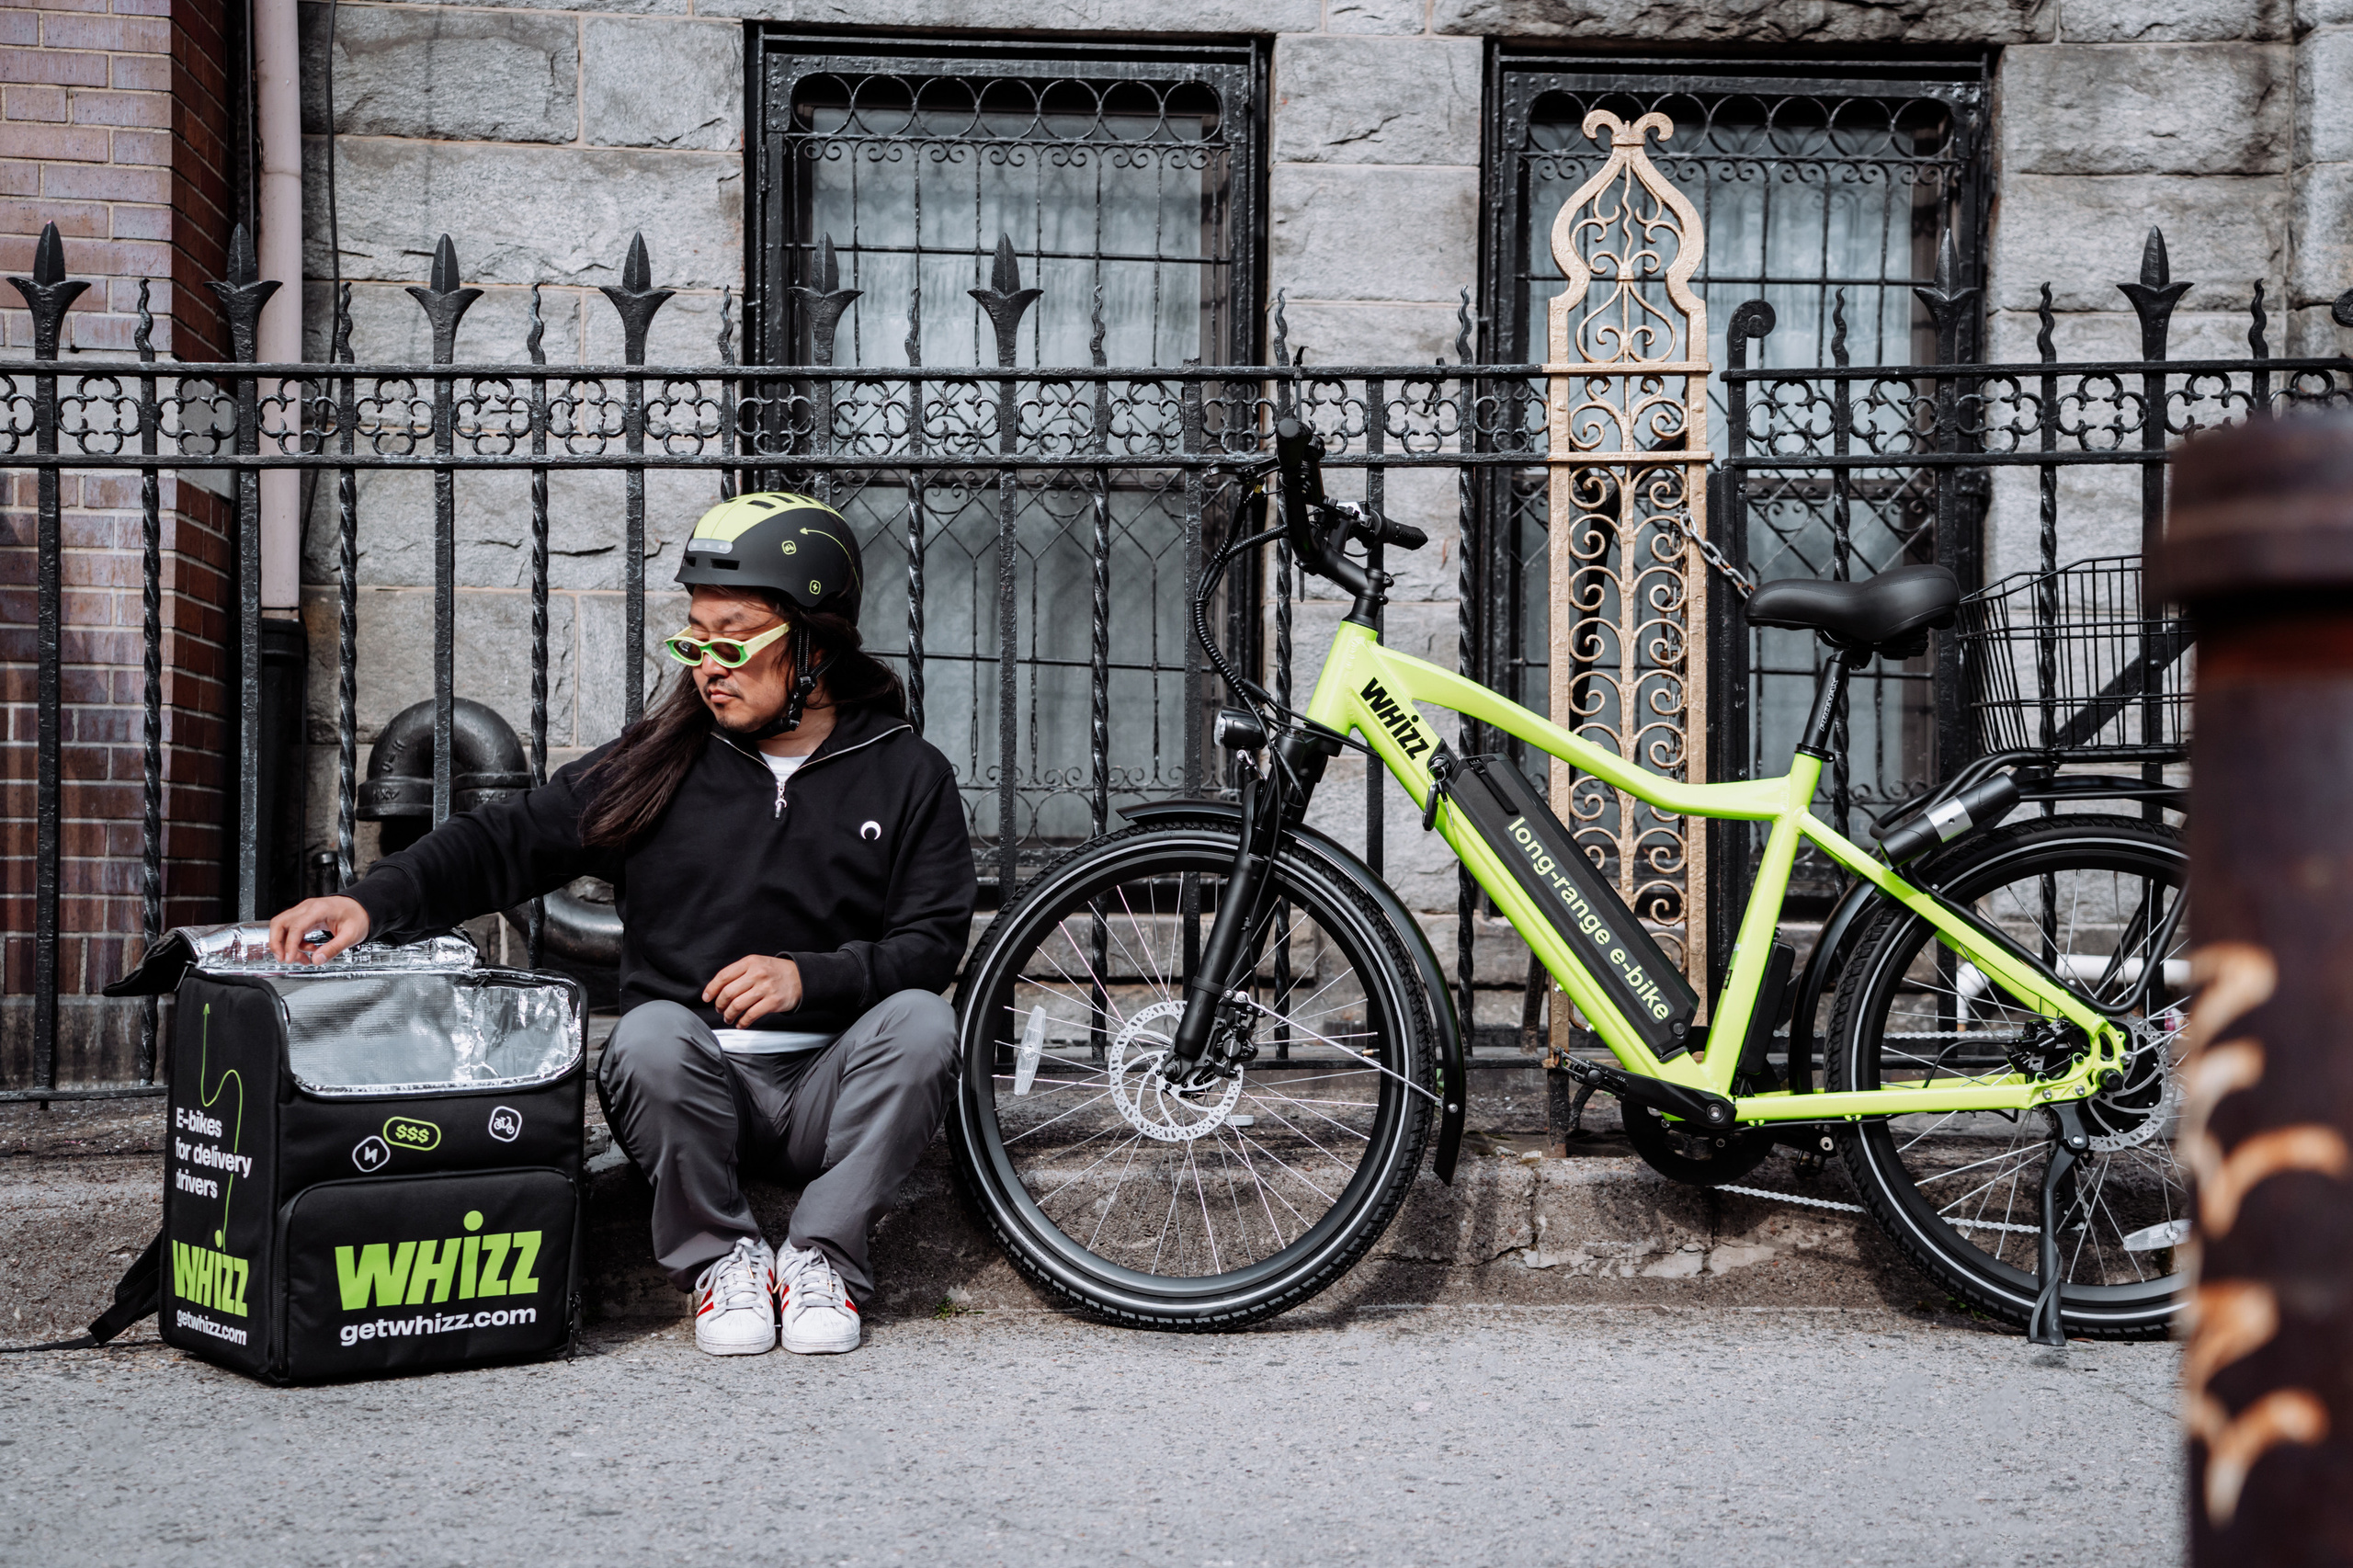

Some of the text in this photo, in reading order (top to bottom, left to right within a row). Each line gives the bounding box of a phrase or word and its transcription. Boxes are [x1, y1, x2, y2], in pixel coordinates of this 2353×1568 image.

[1507, 816, 1669, 1020] long-range e-bike
[176, 1107, 222, 1138] E-bikes
[395, 1124, 430, 1143] $$$
[175, 1136, 252, 1178] for delivery
[176, 1168, 218, 1199] drivers
[176, 1309, 247, 1346] getwhizz.com
[339, 1307, 537, 1346] getwhizz.com
